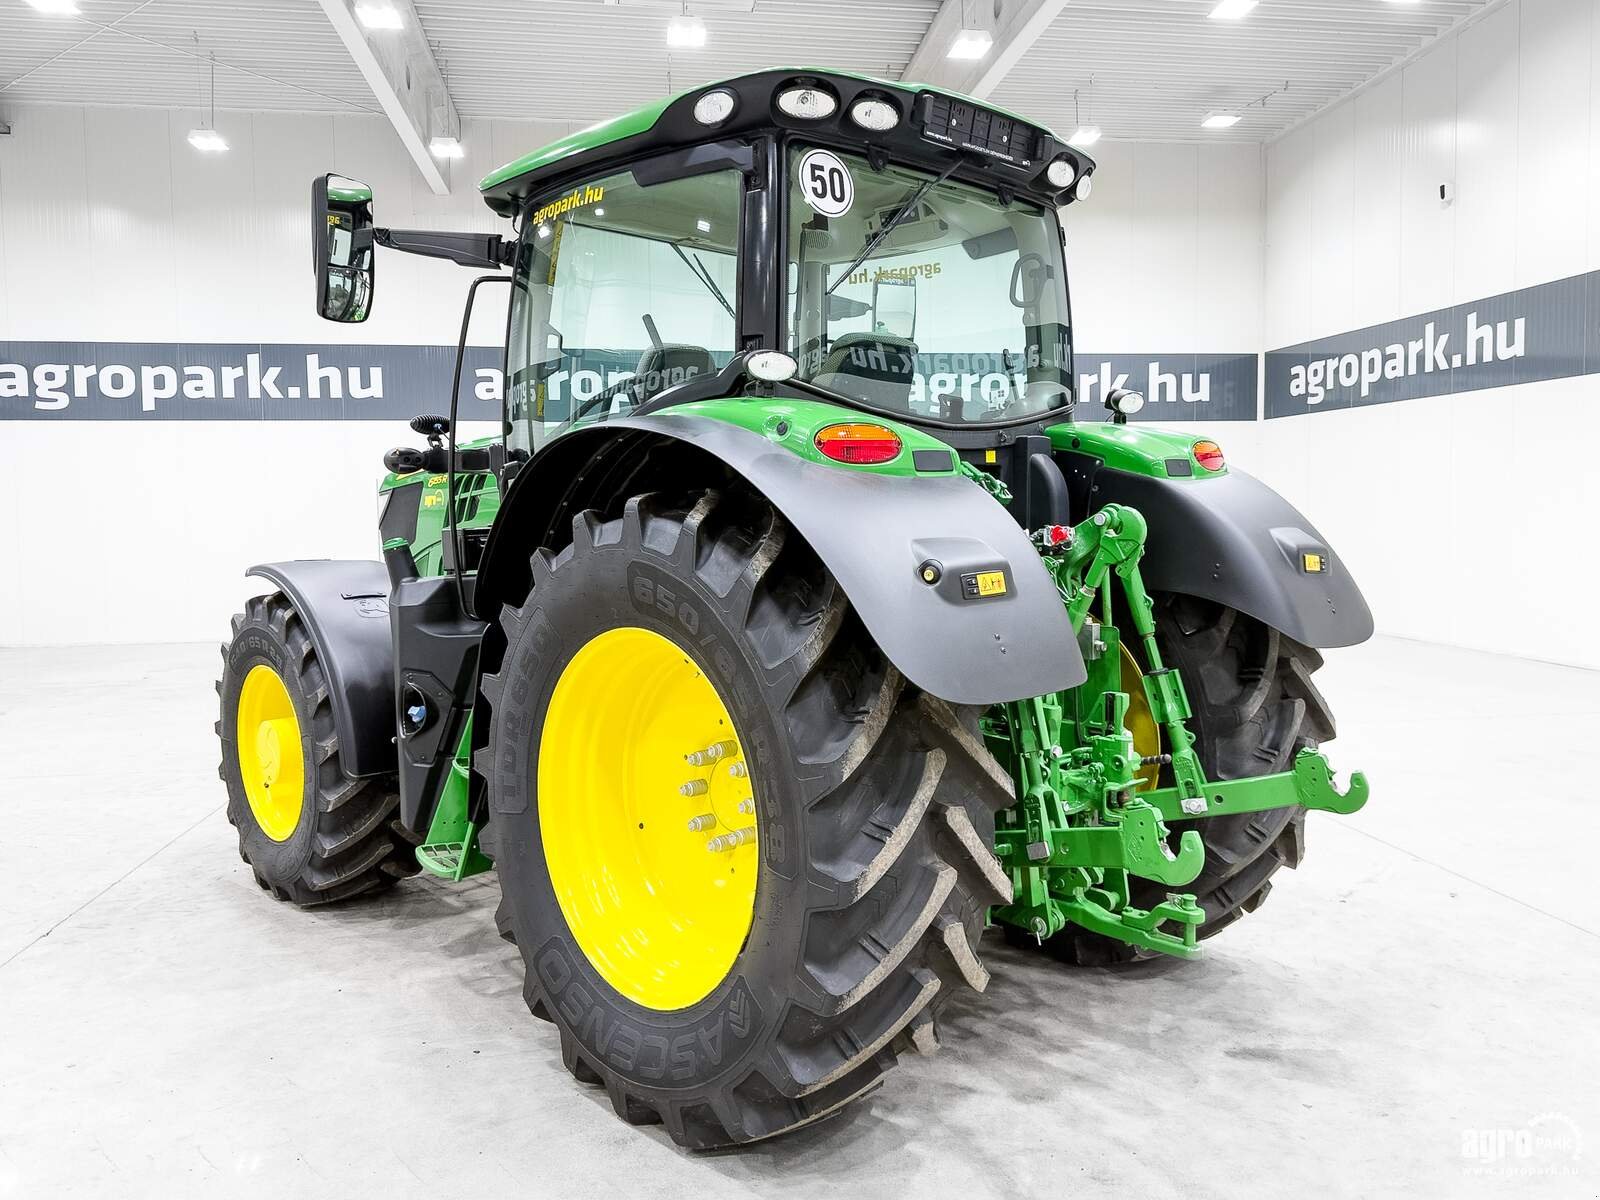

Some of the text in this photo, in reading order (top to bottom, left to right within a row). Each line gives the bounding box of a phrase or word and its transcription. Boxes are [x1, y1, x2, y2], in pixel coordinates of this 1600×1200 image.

[533, 185, 604, 226] agropark.hu
[810, 163, 846, 203] 50
[0, 353, 384, 411] agropark.hu
[1289, 311, 1527, 404] agropark.hu
[537, 948, 725, 1081] ASCENSO
